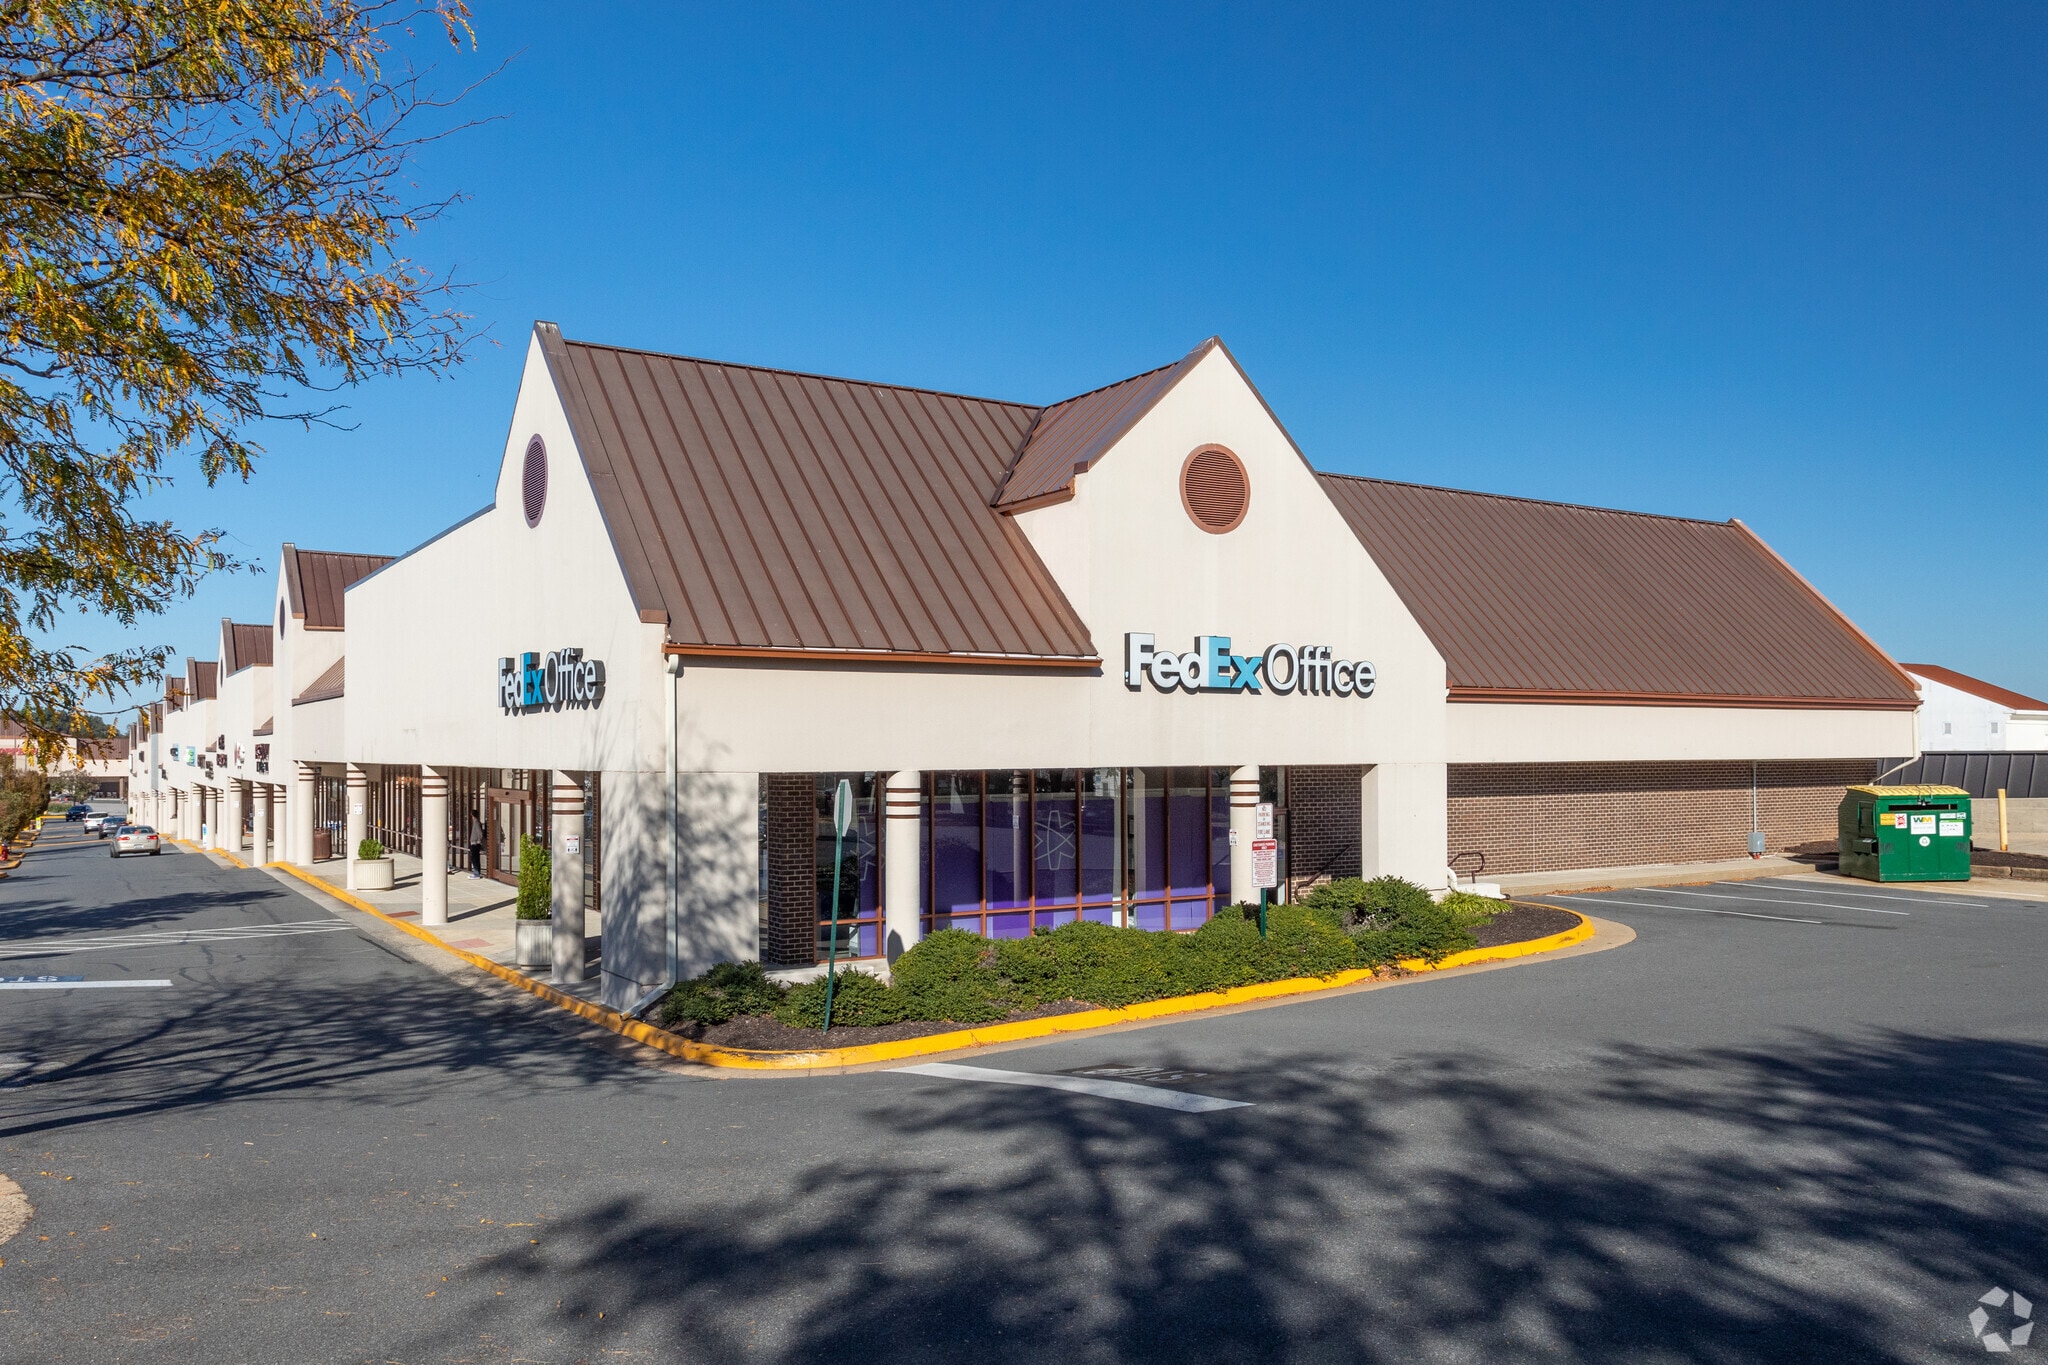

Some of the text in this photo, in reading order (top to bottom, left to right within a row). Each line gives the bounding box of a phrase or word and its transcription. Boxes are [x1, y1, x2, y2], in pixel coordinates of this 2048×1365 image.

[498, 648, 605, 712] FedEx Office
[1124, 632, 1376, 697] FedEx Office
